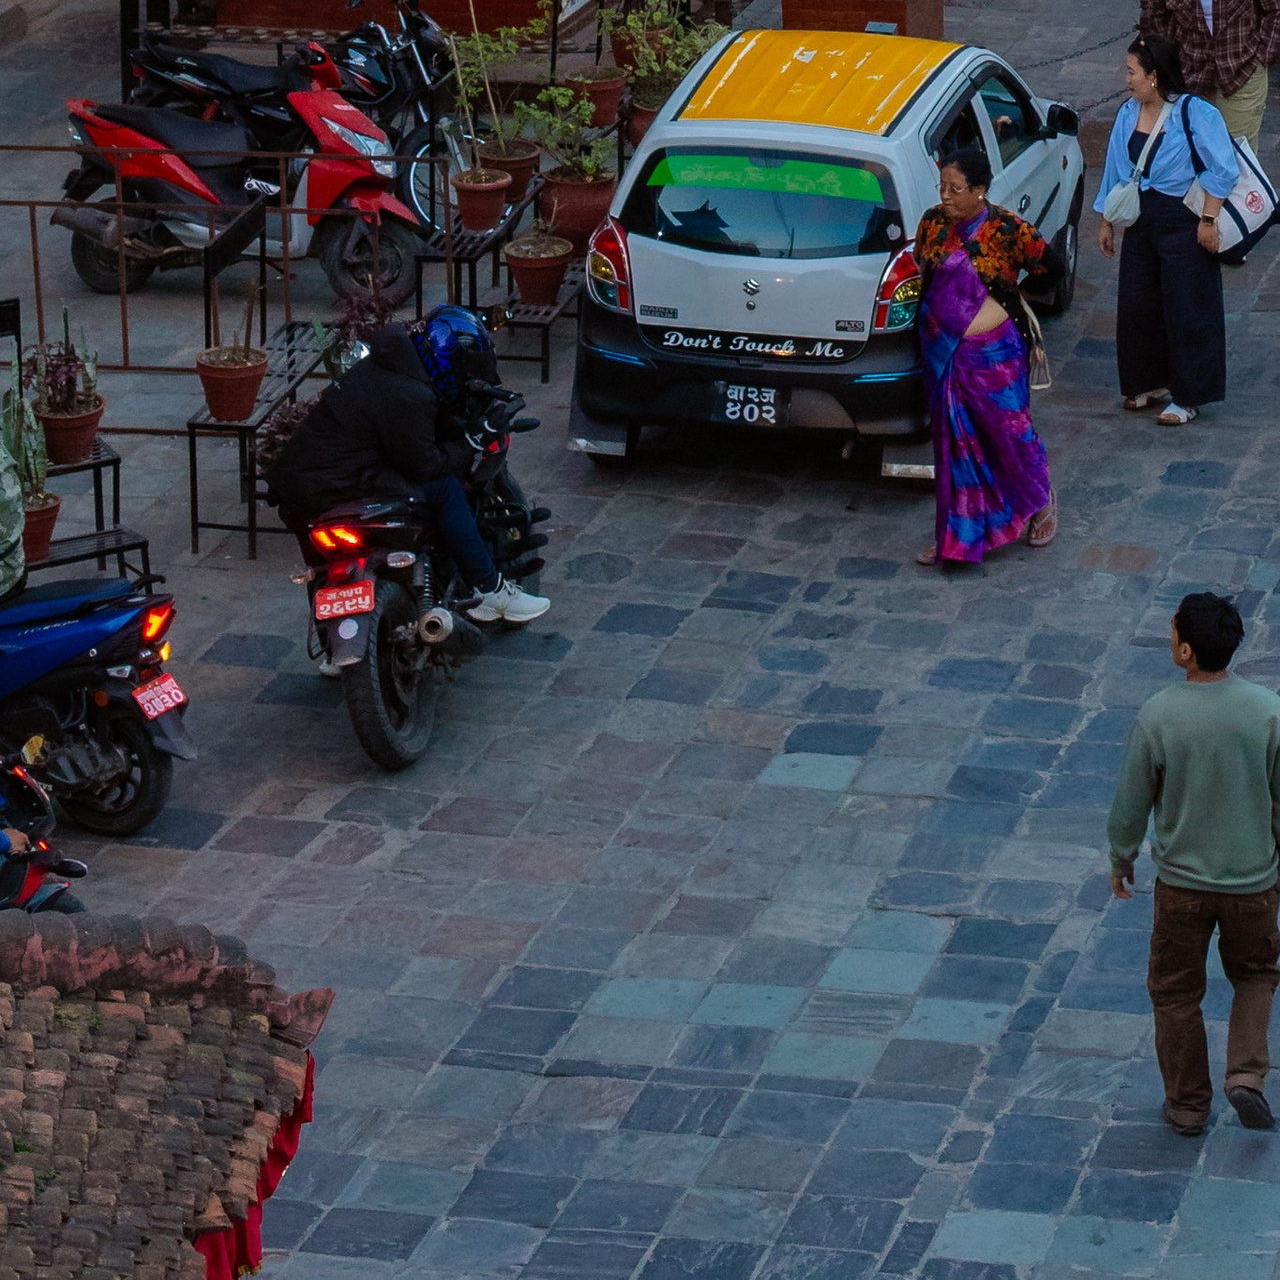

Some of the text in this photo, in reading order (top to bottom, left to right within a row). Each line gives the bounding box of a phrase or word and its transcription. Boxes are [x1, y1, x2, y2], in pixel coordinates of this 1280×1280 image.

[836, 321, 864, 329] ALTO
[663, 330, 845, 358] Don't Touch Me
